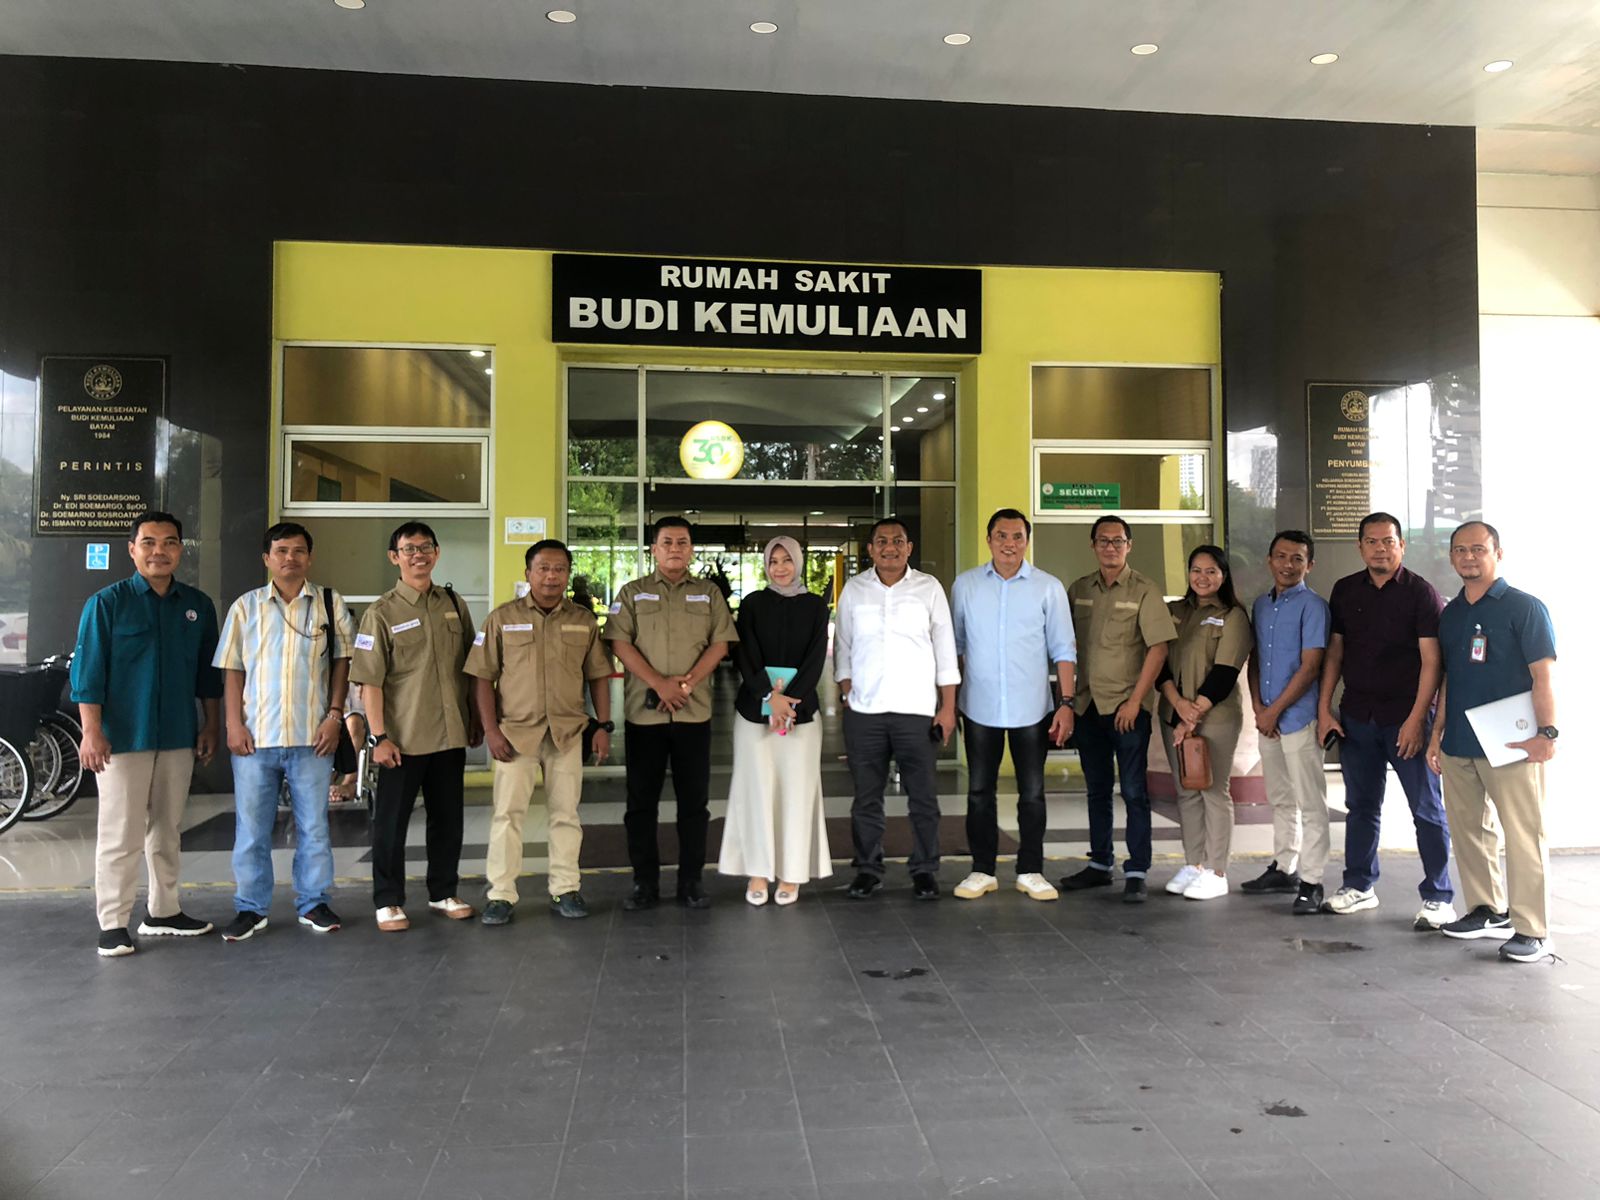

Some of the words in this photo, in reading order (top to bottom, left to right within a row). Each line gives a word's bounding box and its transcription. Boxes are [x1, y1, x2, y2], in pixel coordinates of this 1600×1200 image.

[661, 265, 778, 291] RUMAH
[794, 270, 892, 294] SAKIT
[569, 296, 679, 331] BUDI
[694, 301, 967, 339] KEMULIAAN
[57, 405, 102, 413] PELAYANAN
[60, 461, 143, 471] PERINTIS
[1059, 488, 1110, 497] SECURITY
